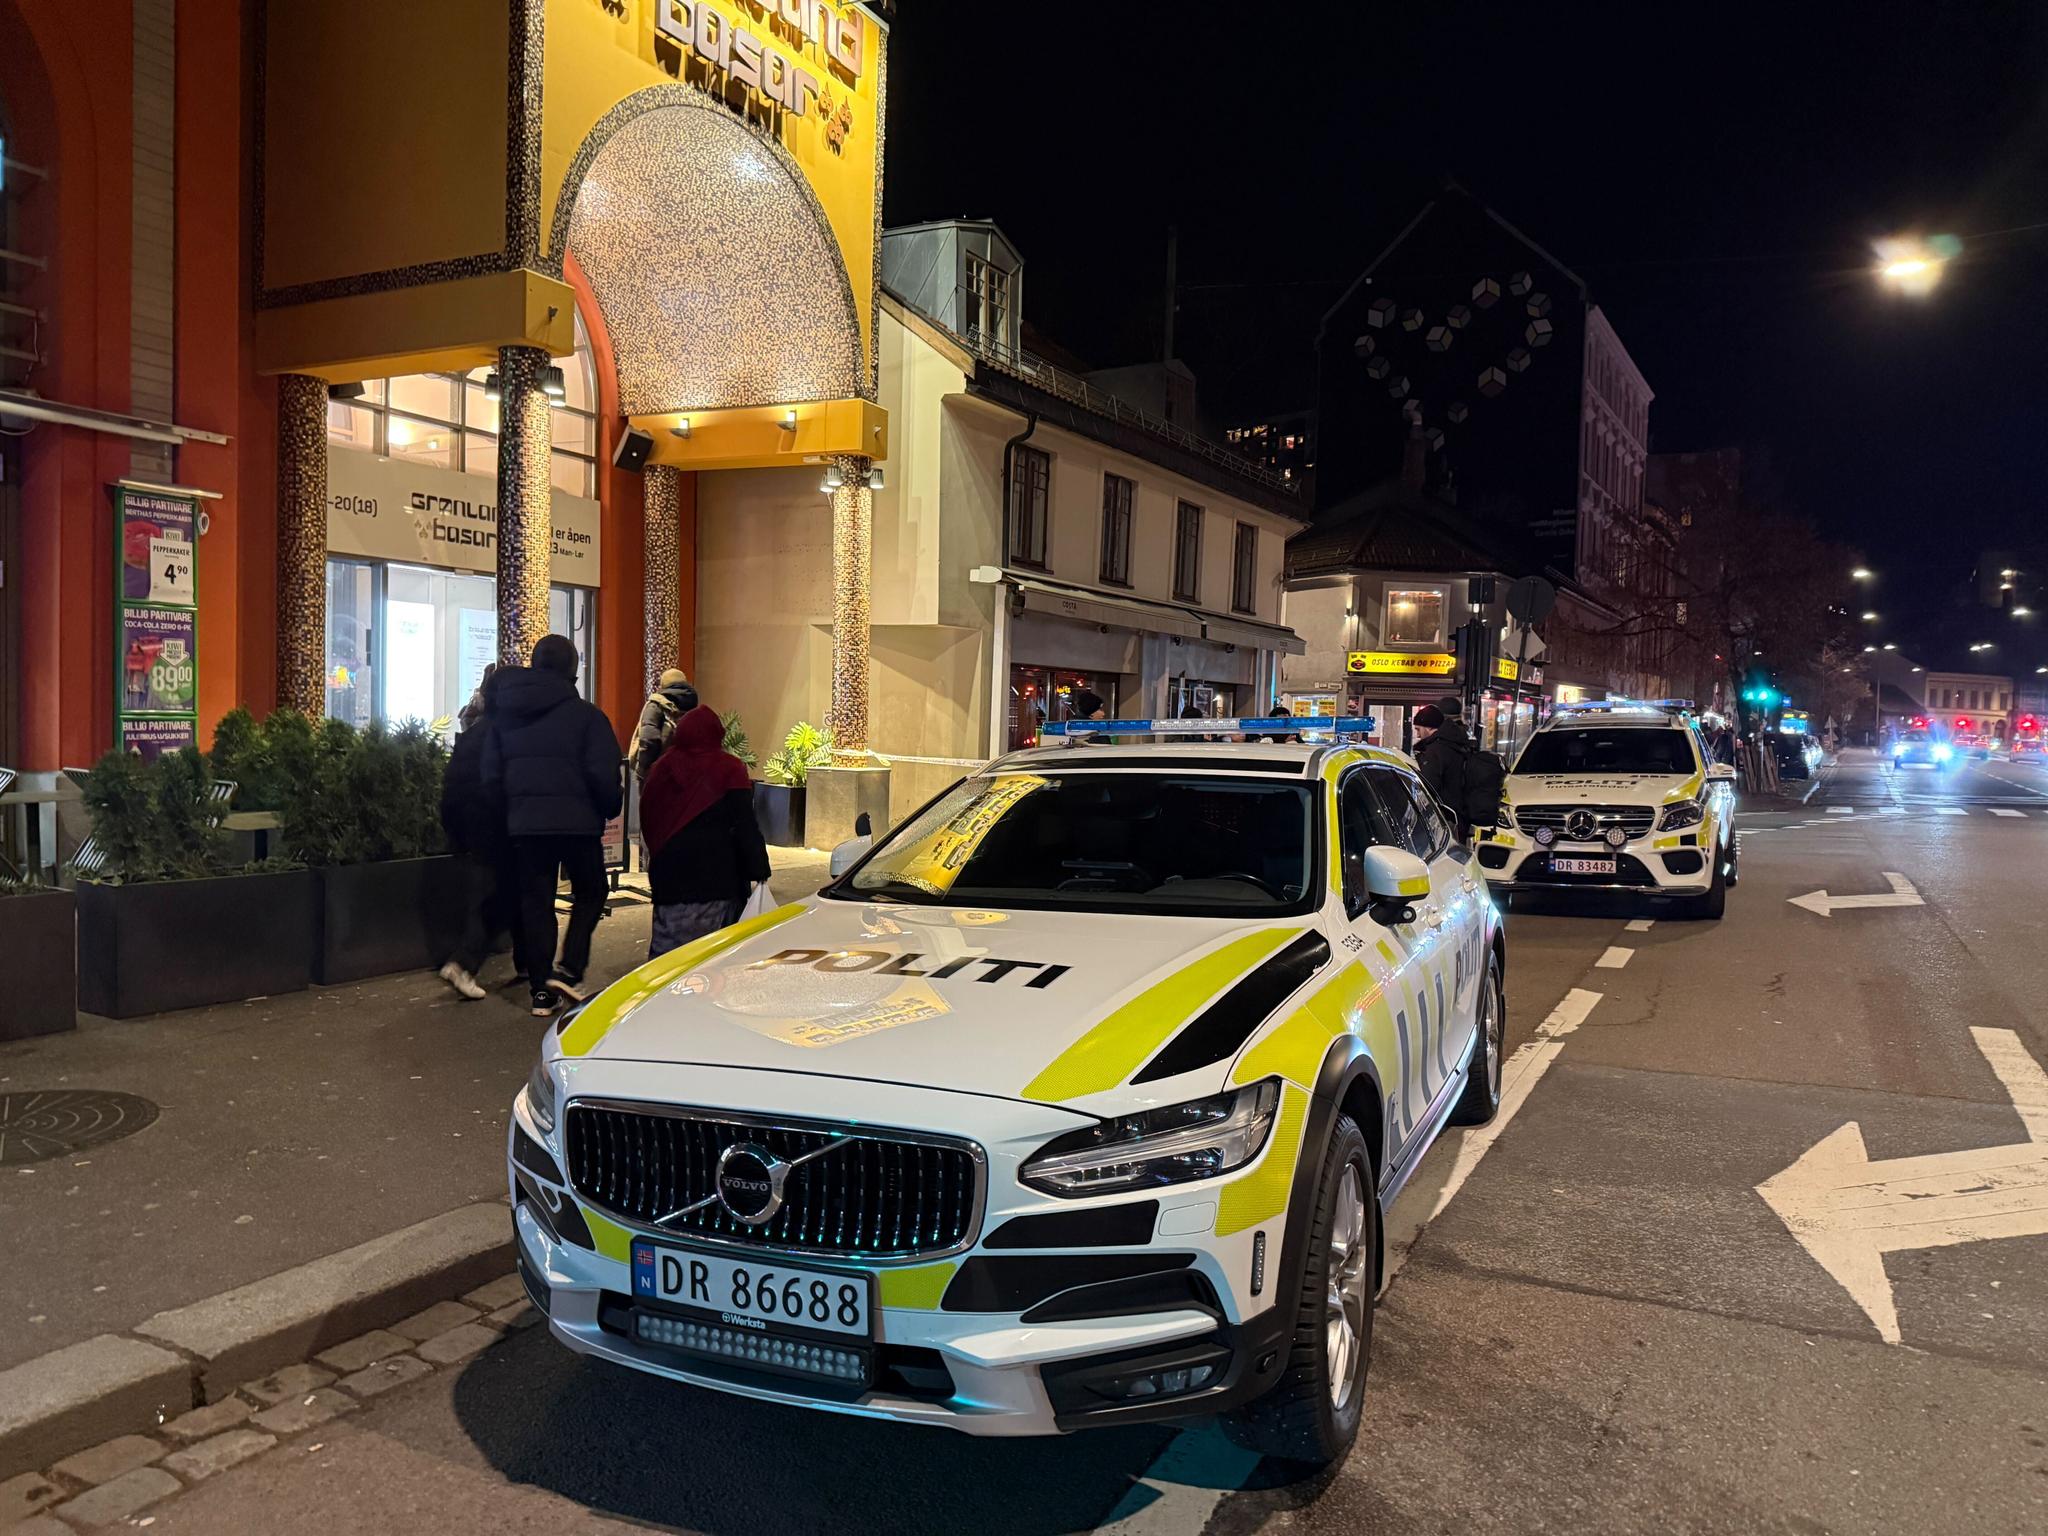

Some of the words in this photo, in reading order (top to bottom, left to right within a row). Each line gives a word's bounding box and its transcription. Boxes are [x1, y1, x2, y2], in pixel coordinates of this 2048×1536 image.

[125, 496, 149, 508] BILLIG
[151, 500, 192, 513] PARTIVARE
[555, 529, 566, 540] er
[567, 526, 591, 544] åpen
[153, 545, 190, 556] PEPPERKAKER
[164, 564, 177, 585] 4
[177, 565, 188, 575] 90
[124, 608, 148, 619] BILLIG
[150, 610, 192, 622] PARTIVARE
[124, 620, 160, 630] COCA-COLA
[160, 623, 177, 631] ZERO
[1371, 658, 1389, 666] OSLO
[1391, 659, 1416, 667] KEBAB
[151, 666, 179, 692] 89
[178, 667, 193, 682] 00
[122, 721, 148, 731] BILLIG
[148, 721, 192, 731] PARTIVARE
[1556, 859, 1573, 871] DR
[1577, 860, 1614, 873] 83482
[745, 949, 1074, 989] POLITI
[722, 1177, 769, 1192] VOLVO
[641, 1275, 651, 1289] N
[661, 1254, 710, 1303] DR
[731, 1267, 860, 1327] 86688
[730, 1313, 766, 1330] Werksta
